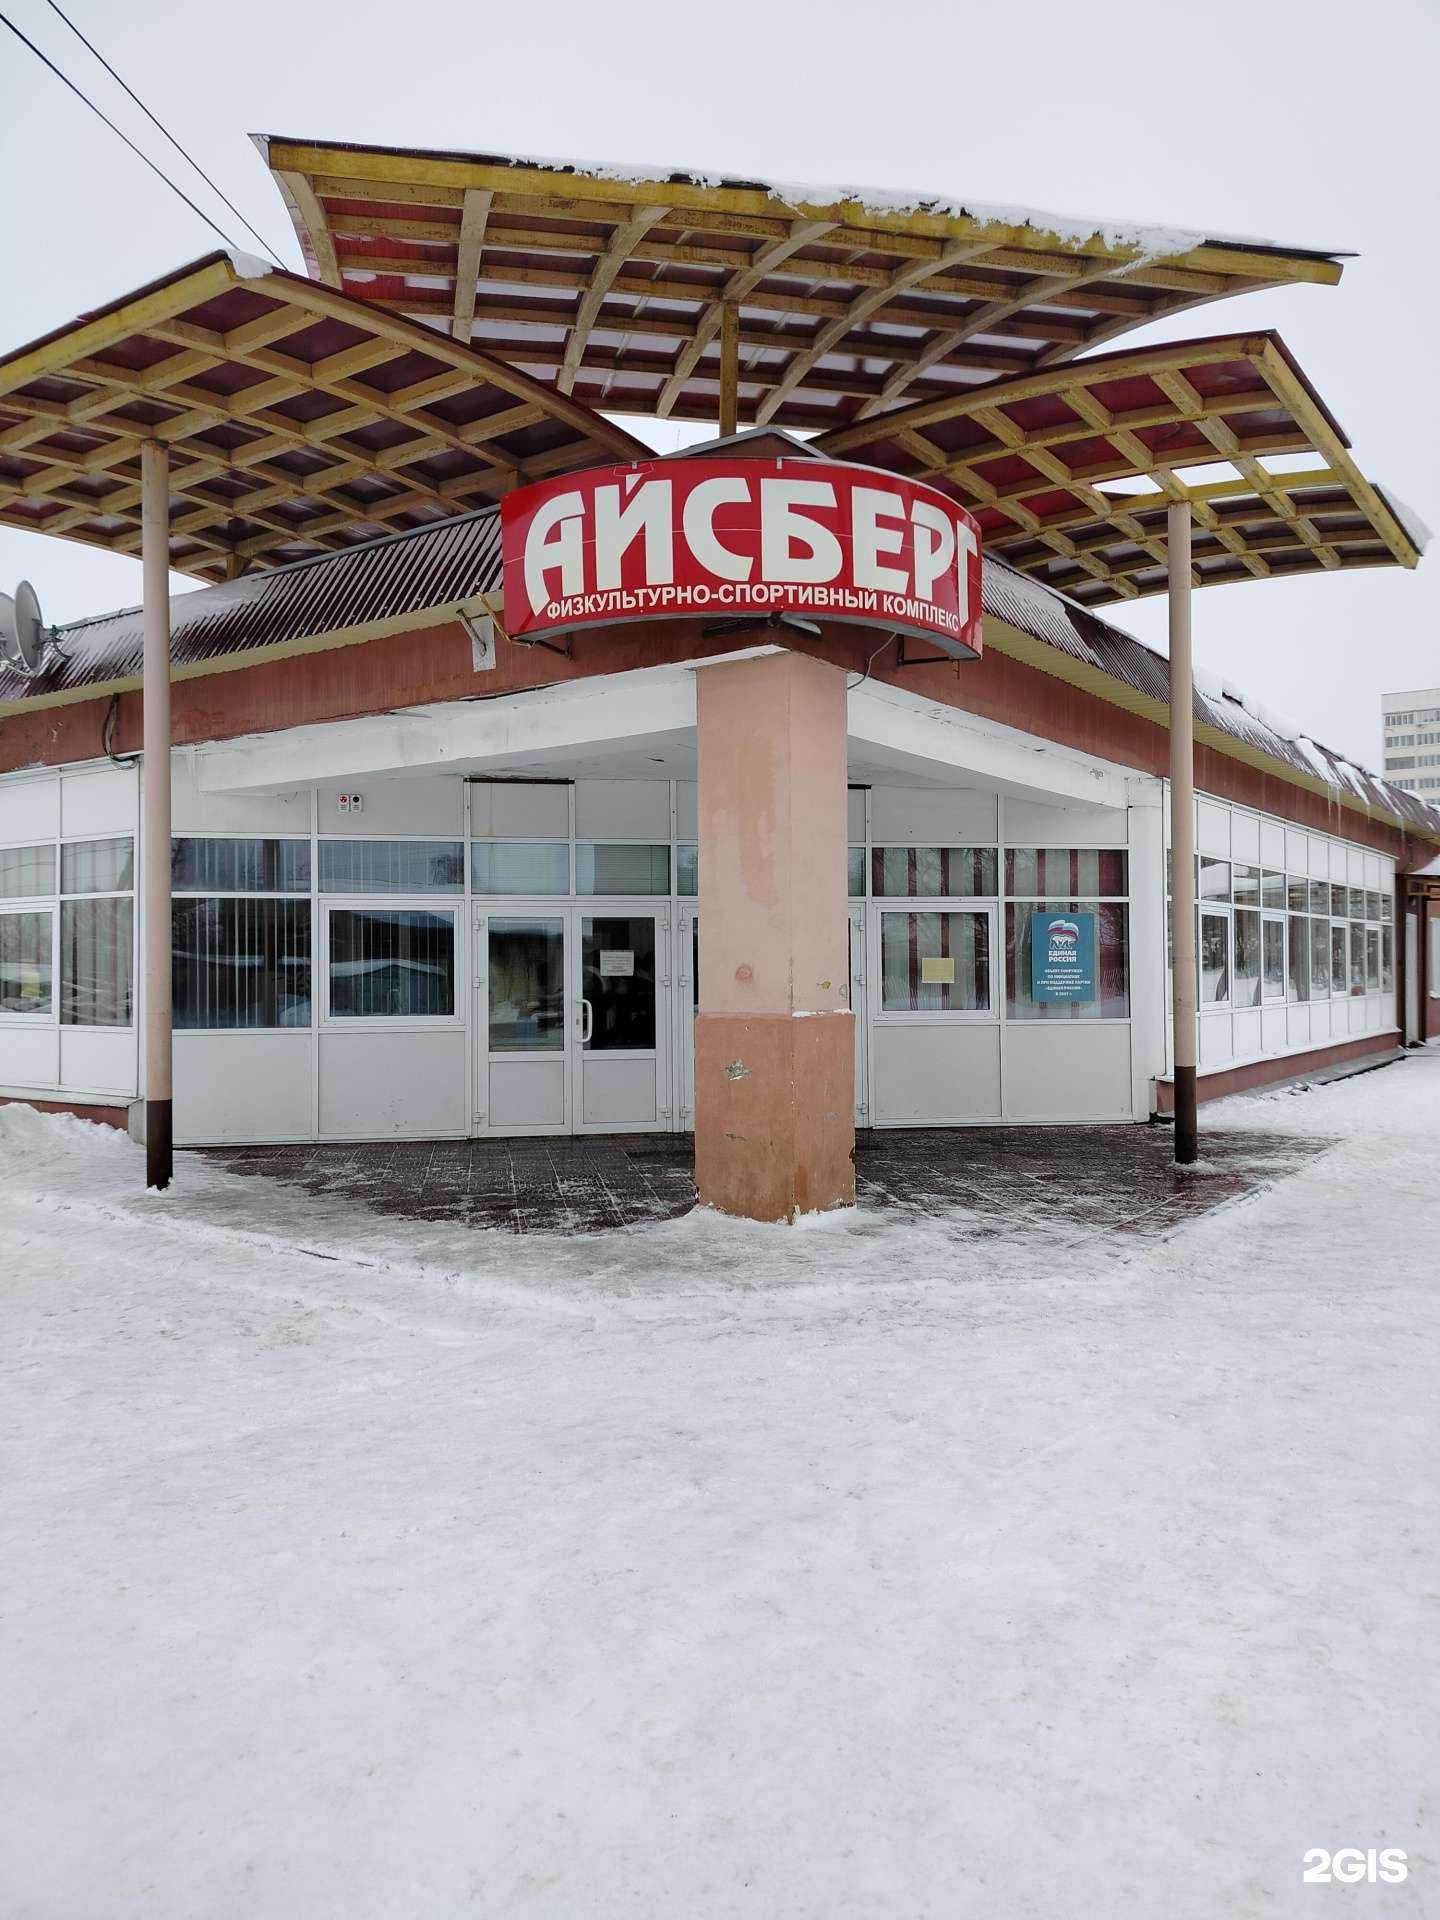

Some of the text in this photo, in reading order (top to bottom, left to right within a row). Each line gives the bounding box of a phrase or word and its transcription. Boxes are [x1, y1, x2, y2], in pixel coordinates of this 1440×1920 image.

[524, 465, 977, 628] АЙСБЕРГ
[547, 584, 960, 632] ФИЗКУЛЬТУРНО-СПОРТИВНЫЙ КОМПЛЕКС
